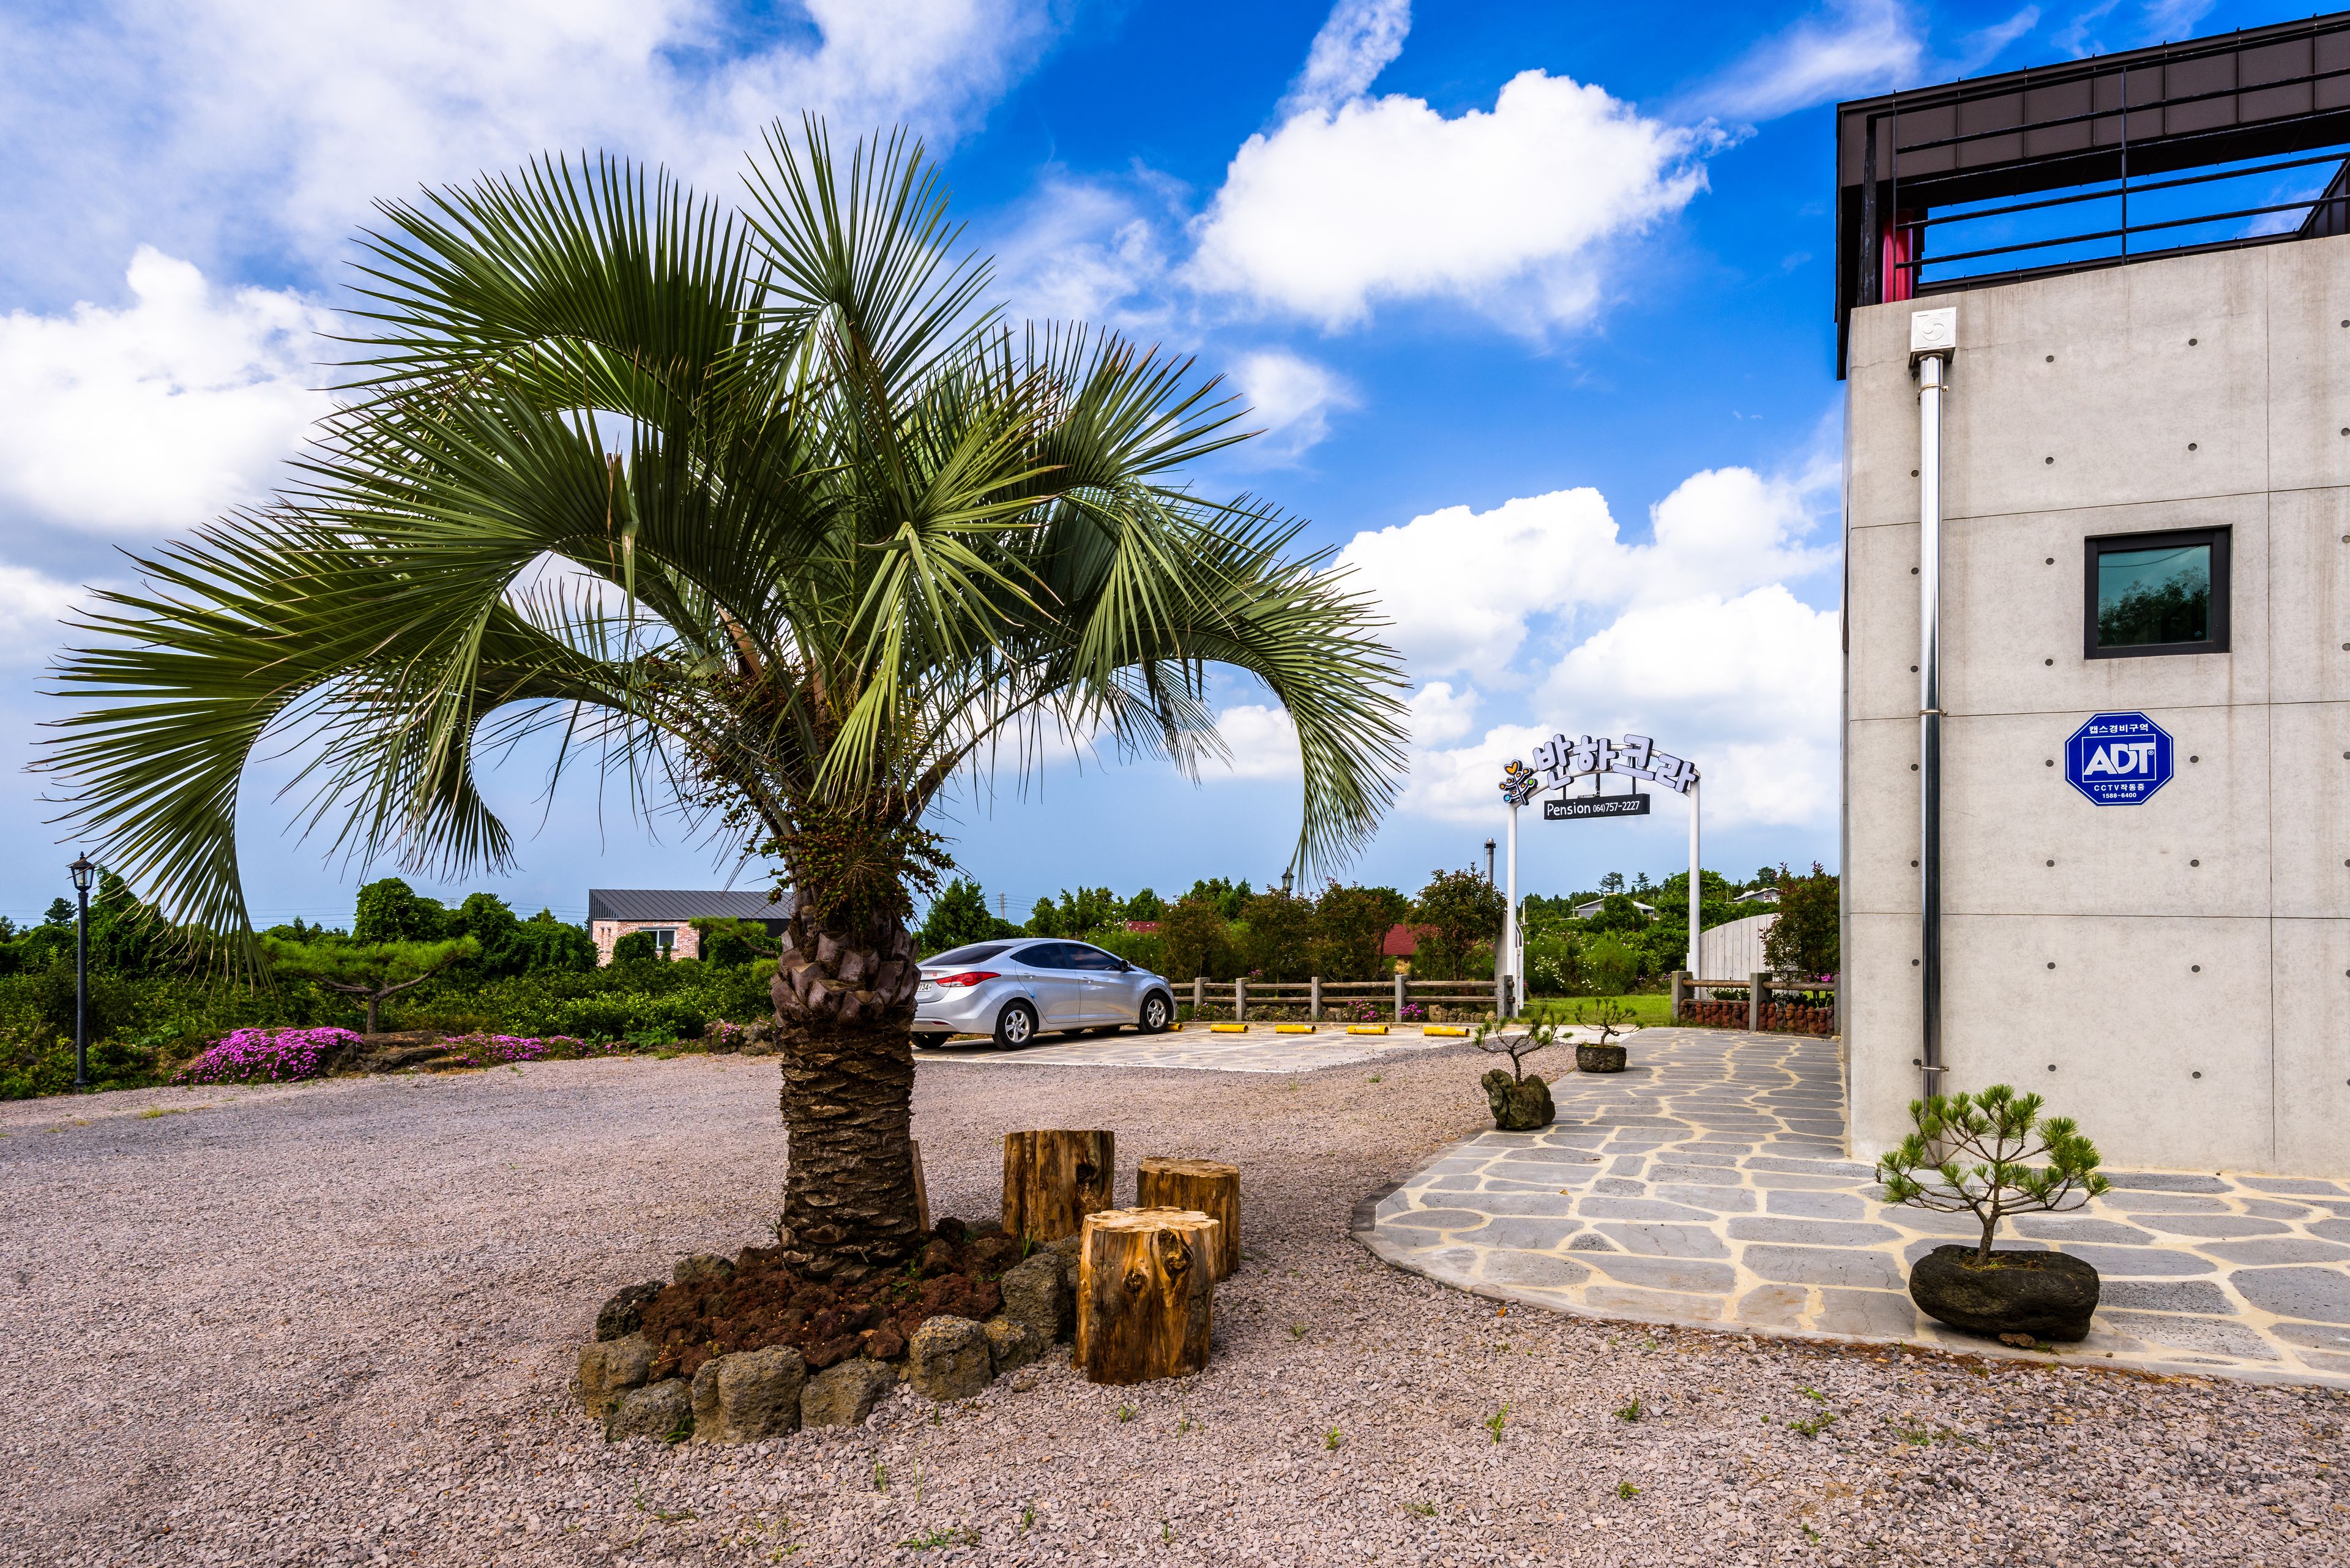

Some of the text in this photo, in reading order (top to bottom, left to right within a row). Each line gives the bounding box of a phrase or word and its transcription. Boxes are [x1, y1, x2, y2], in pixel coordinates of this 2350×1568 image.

[2089, 723, 2148, 734] 캡스경비구역
[1532, 734, 1699, 793] 반하크라
[2083, 742, 2155, 775] ADT
[1547, 801, 1639, 816] Pension 064)757-2227
